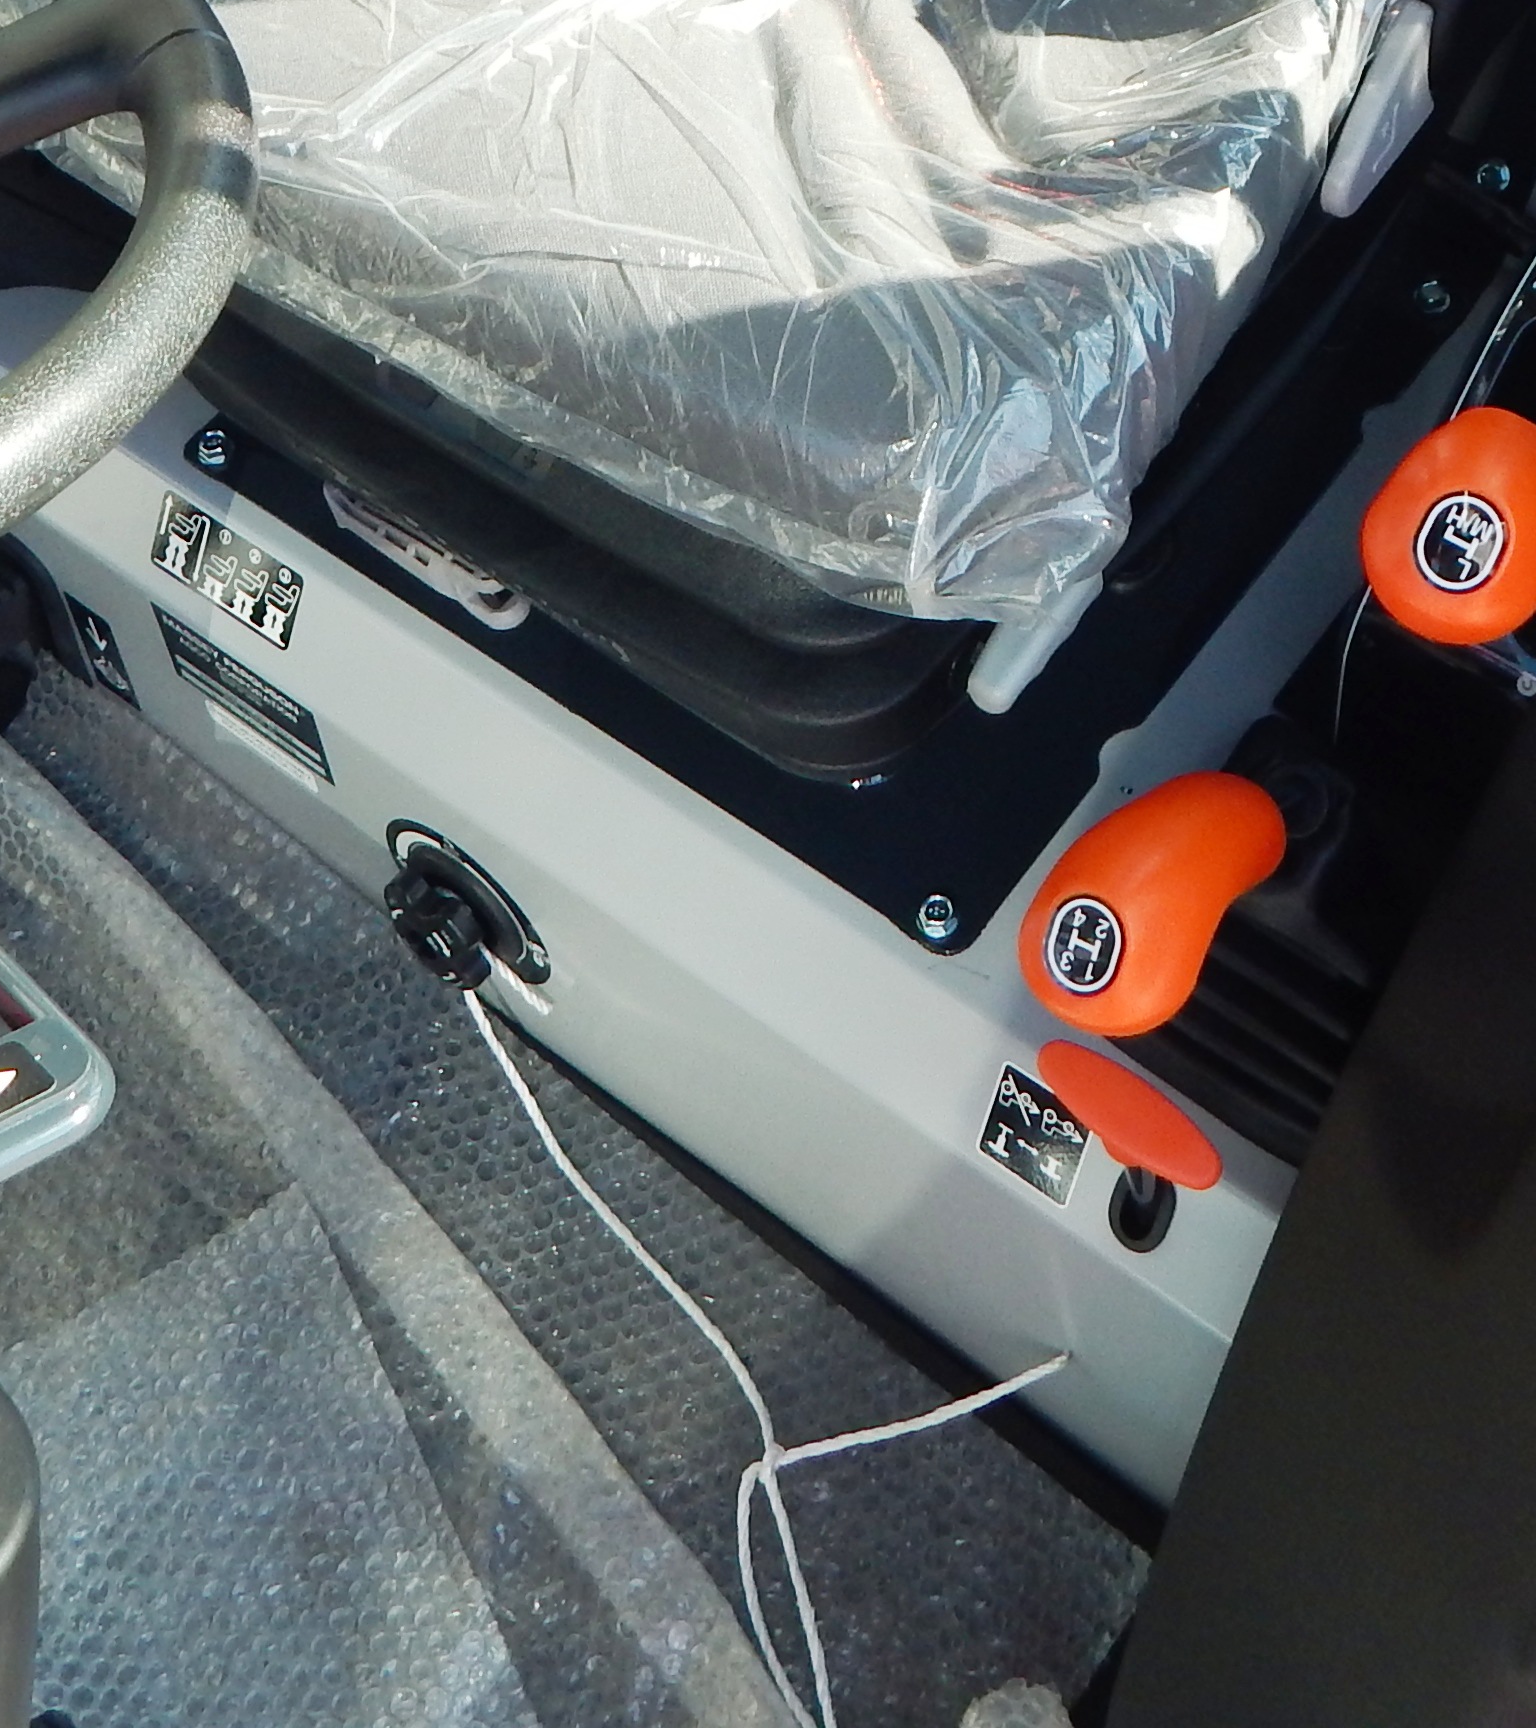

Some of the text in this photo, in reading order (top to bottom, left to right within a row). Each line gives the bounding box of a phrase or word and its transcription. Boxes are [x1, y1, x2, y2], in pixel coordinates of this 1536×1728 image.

[1458, 557, 1472, 580] L
[1073, 908, 1087, 927] 4
[1095, 918, 1110, 939] 2
[1060, 951, 1074, 971] 3
[1084, 962, 1094, 981] 1
